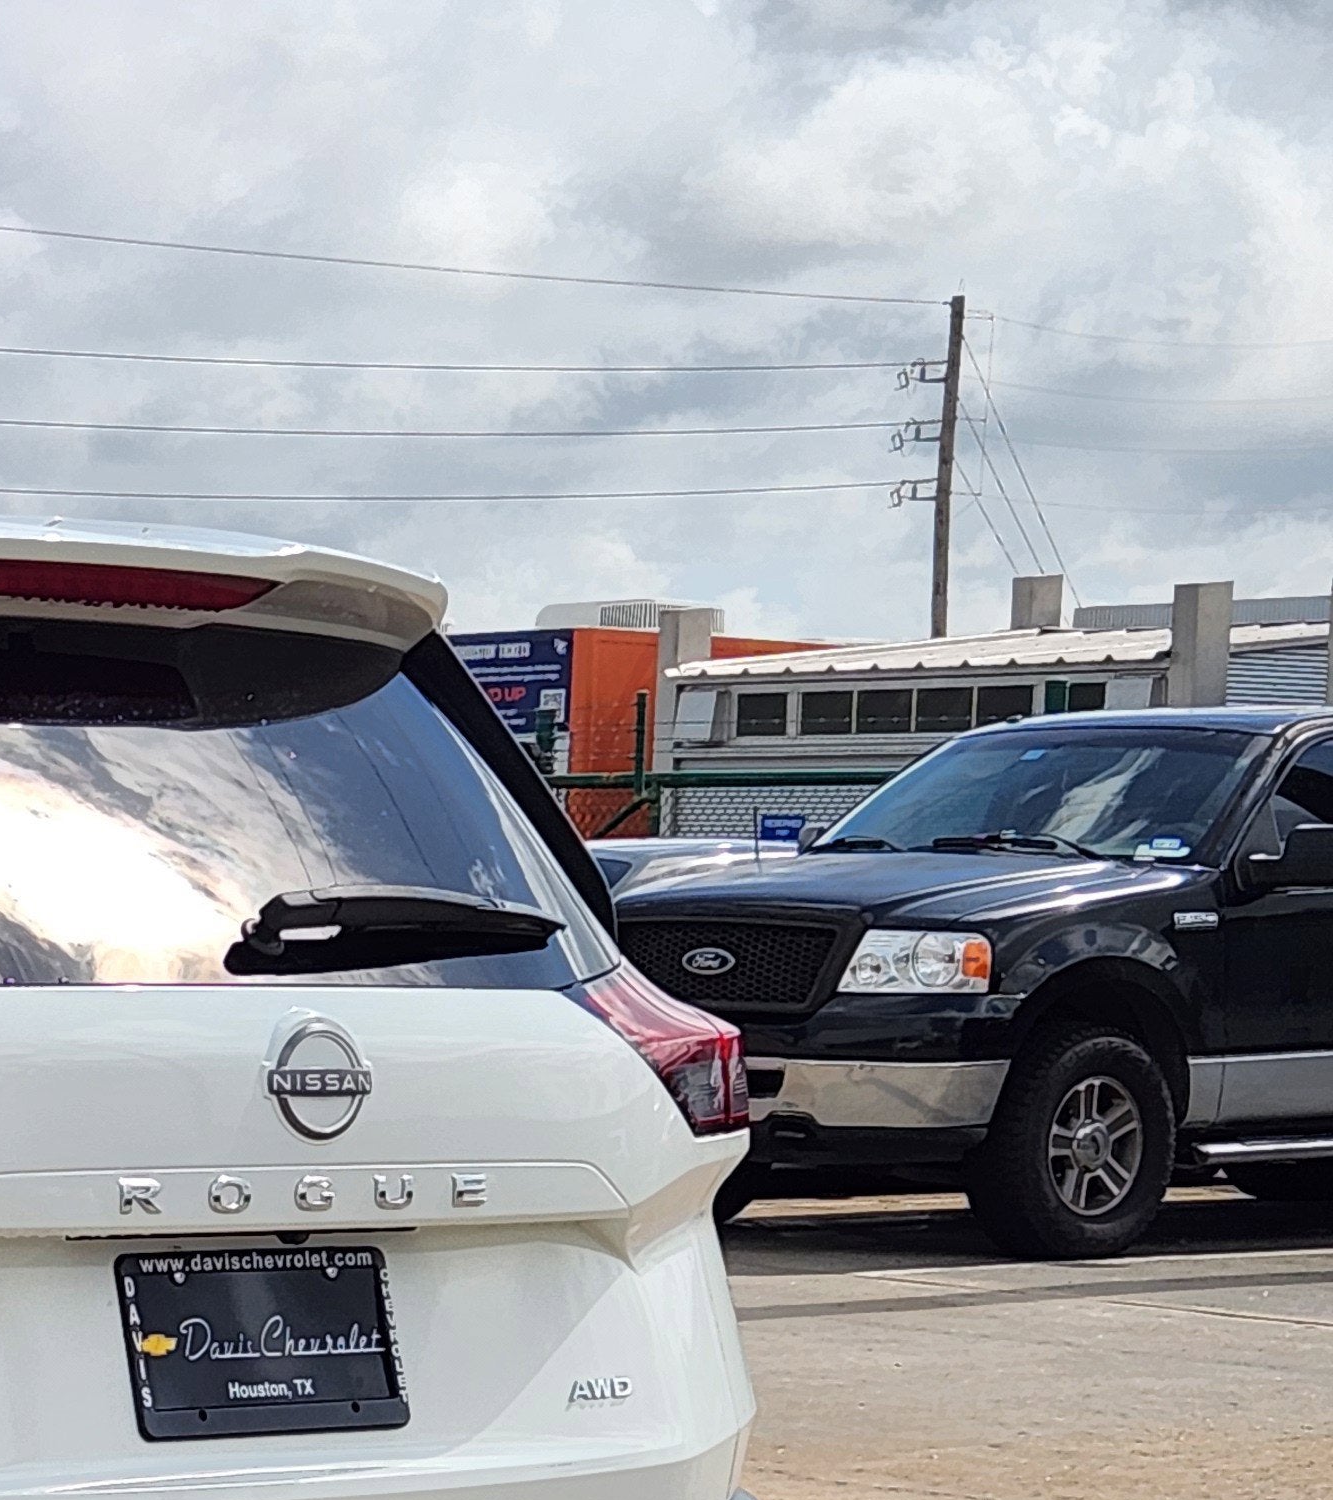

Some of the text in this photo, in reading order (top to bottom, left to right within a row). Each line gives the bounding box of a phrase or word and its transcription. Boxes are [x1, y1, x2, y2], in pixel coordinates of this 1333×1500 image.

[273, 1072, 371, 1093] NISSAN
[118, 1173, 487, 1214] ROGUE
[139, 1251, 373, 1273] www.davischevrolet.com
[123, 1276, 152, 1408] DAVIS
[179, 1315, 386, 1361] Davis Chevrolet
[228, 1378, 316, 1400] Houston, TX
[568, 1375, 633, 1403] AWD
